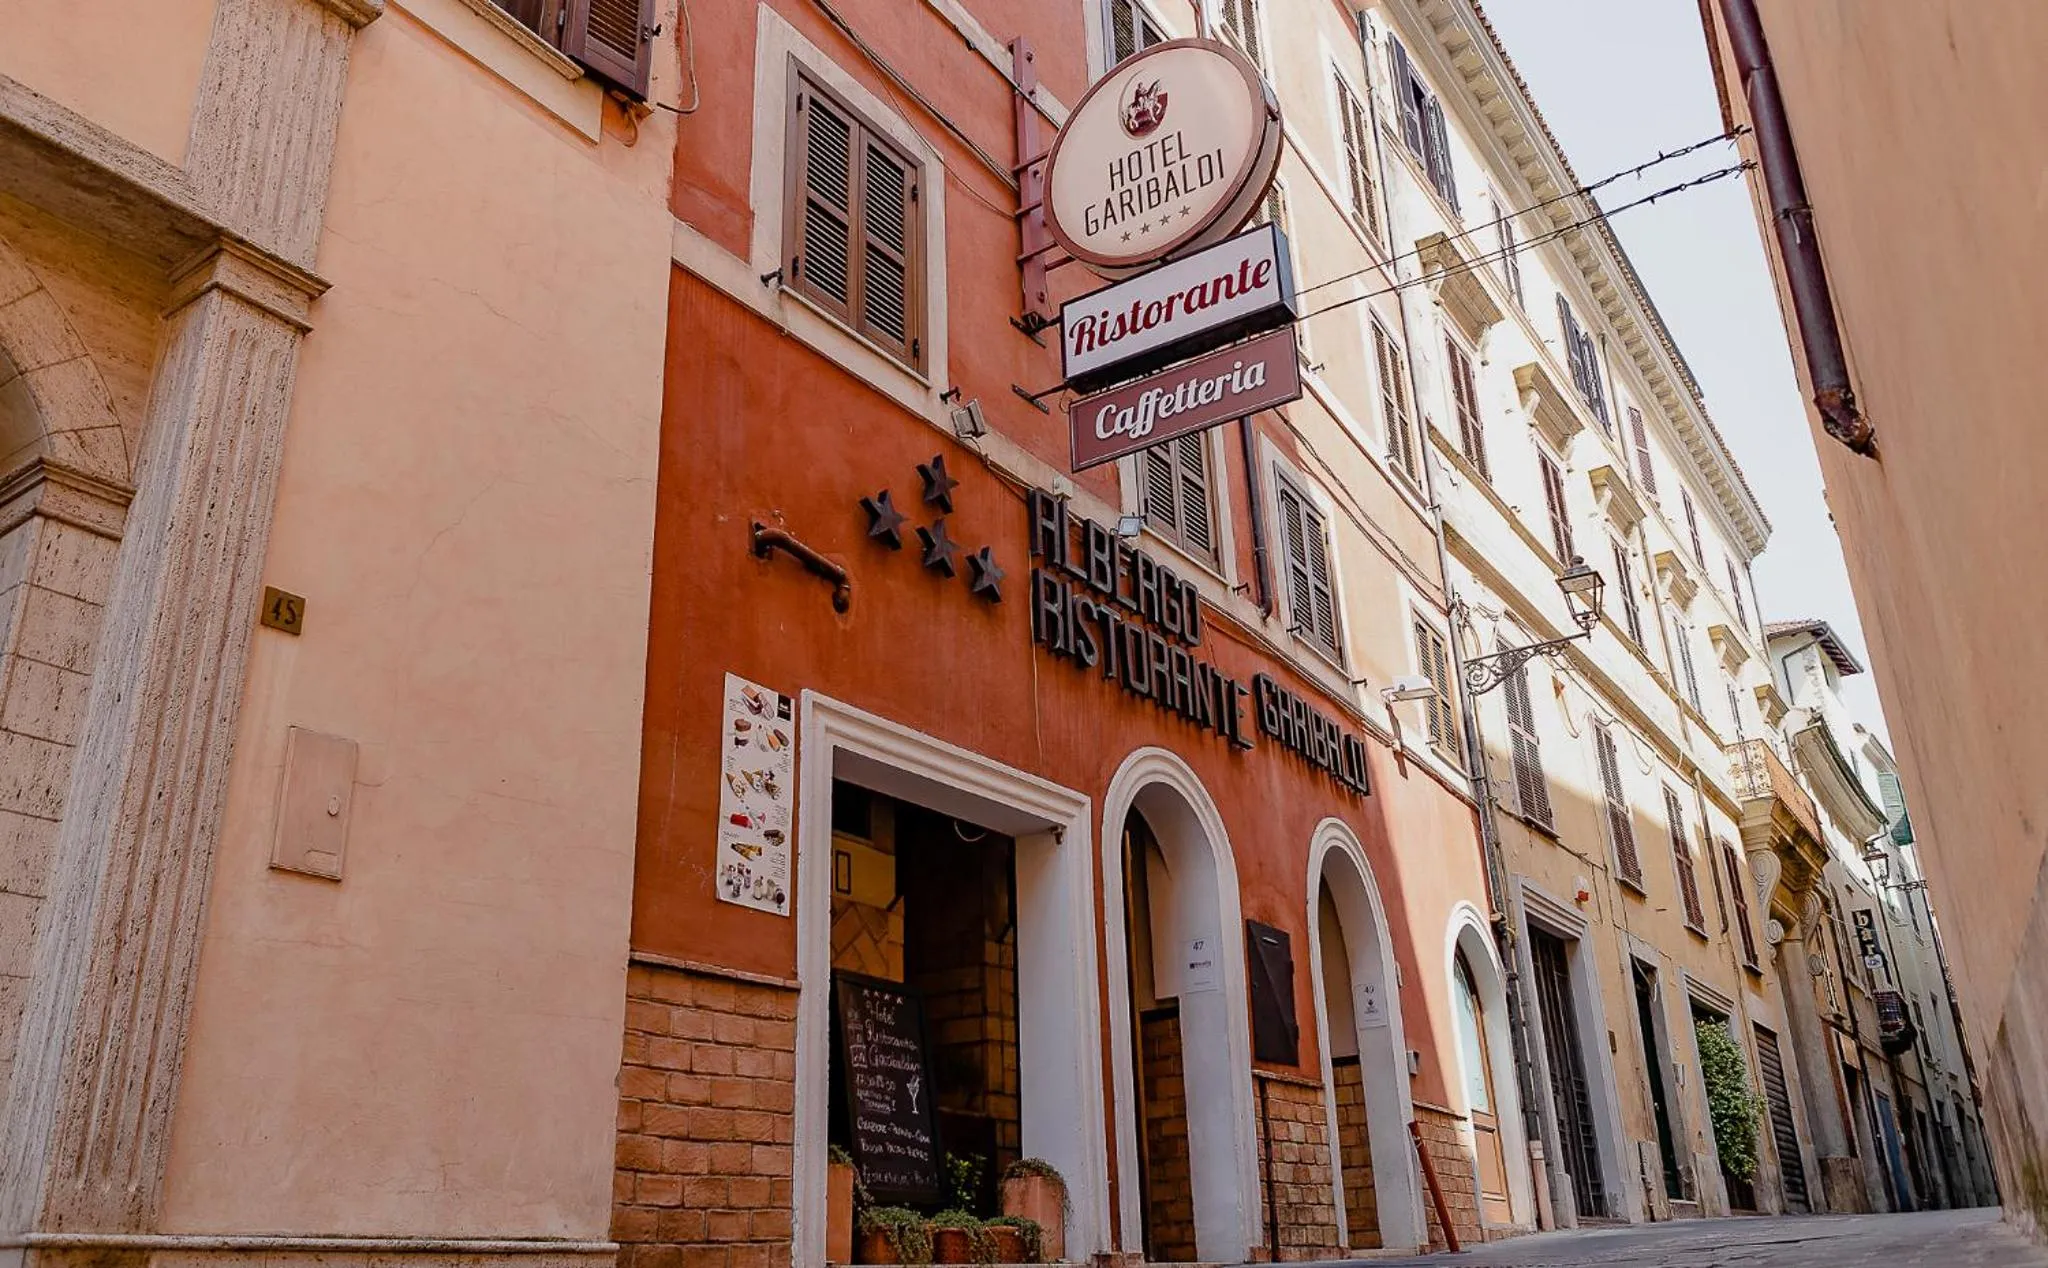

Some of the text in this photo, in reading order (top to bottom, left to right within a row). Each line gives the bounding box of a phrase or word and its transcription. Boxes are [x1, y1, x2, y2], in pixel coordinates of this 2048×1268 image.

[1084, 148, 1226, 237] GARIBALDI
[1108, 130, 1192, 192] HOTEL
[1068, 256, 1272, 357] Ristorante
[1094, 359, 1266, 441] Caffetteria
[1027, 486, 1200, 648] ALBERGO
[272, 597, 297, 625] 45
[1030, 566, 1255, 751] RISTORANTE
[1192, 940, 1204, 951] 47
